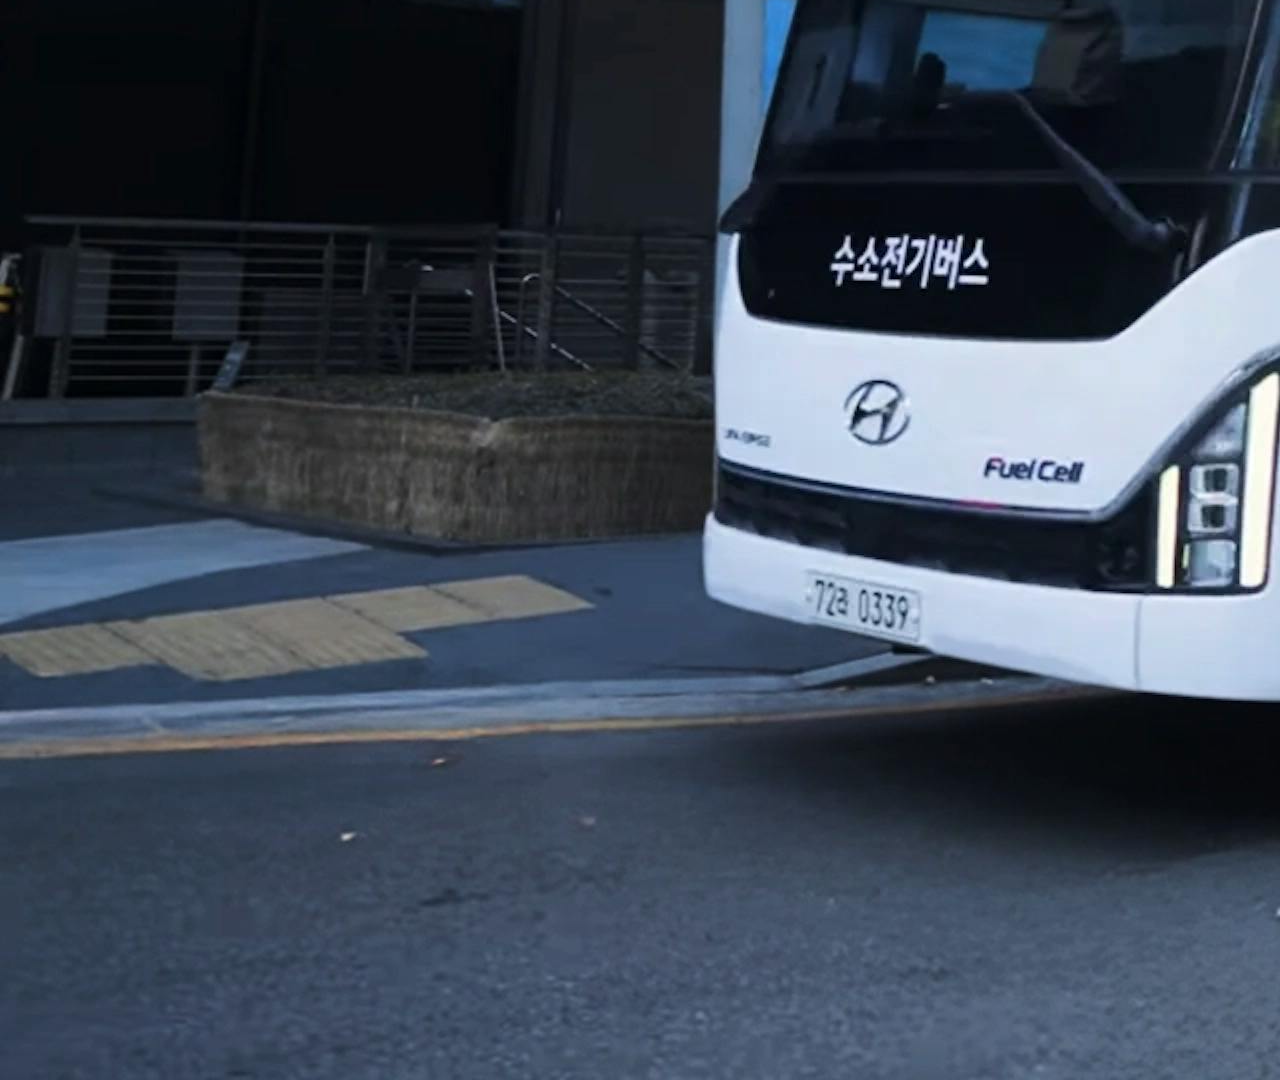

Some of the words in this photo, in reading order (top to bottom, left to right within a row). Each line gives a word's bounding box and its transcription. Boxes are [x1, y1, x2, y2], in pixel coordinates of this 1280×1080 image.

[830, 234, 989, 290] 수소전기버스
[983, 456, 1036, 481] Fuel
[1037, 459, 1085, 483] Cell
[858, 588, 910, 631] 0339
